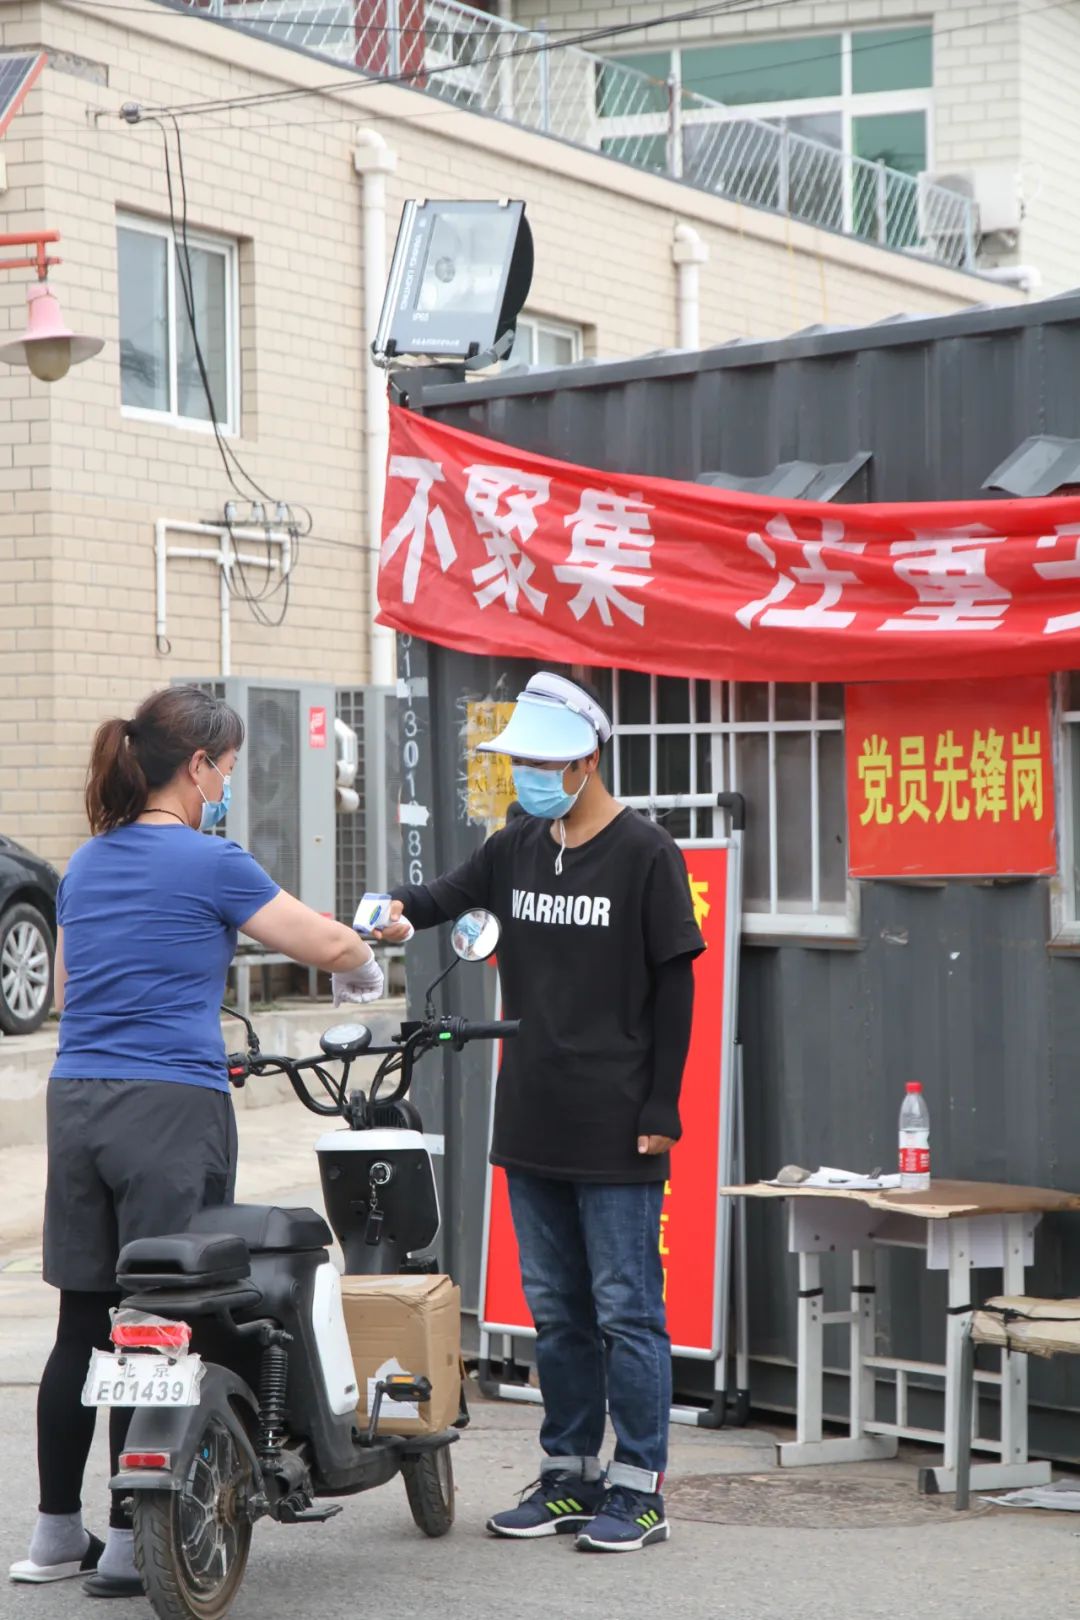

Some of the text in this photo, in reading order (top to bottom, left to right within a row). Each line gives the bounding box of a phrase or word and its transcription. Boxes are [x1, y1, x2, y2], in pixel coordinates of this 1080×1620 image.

[380, 455, 656, 627] 不聚集
[858, 726, 1043, 826] 党员先锋岗
[512, 888, 611, 927] WARRIOR
[119, 1363, 170, 1378] 北京
[97, 1380, 184, 1402] E01439
